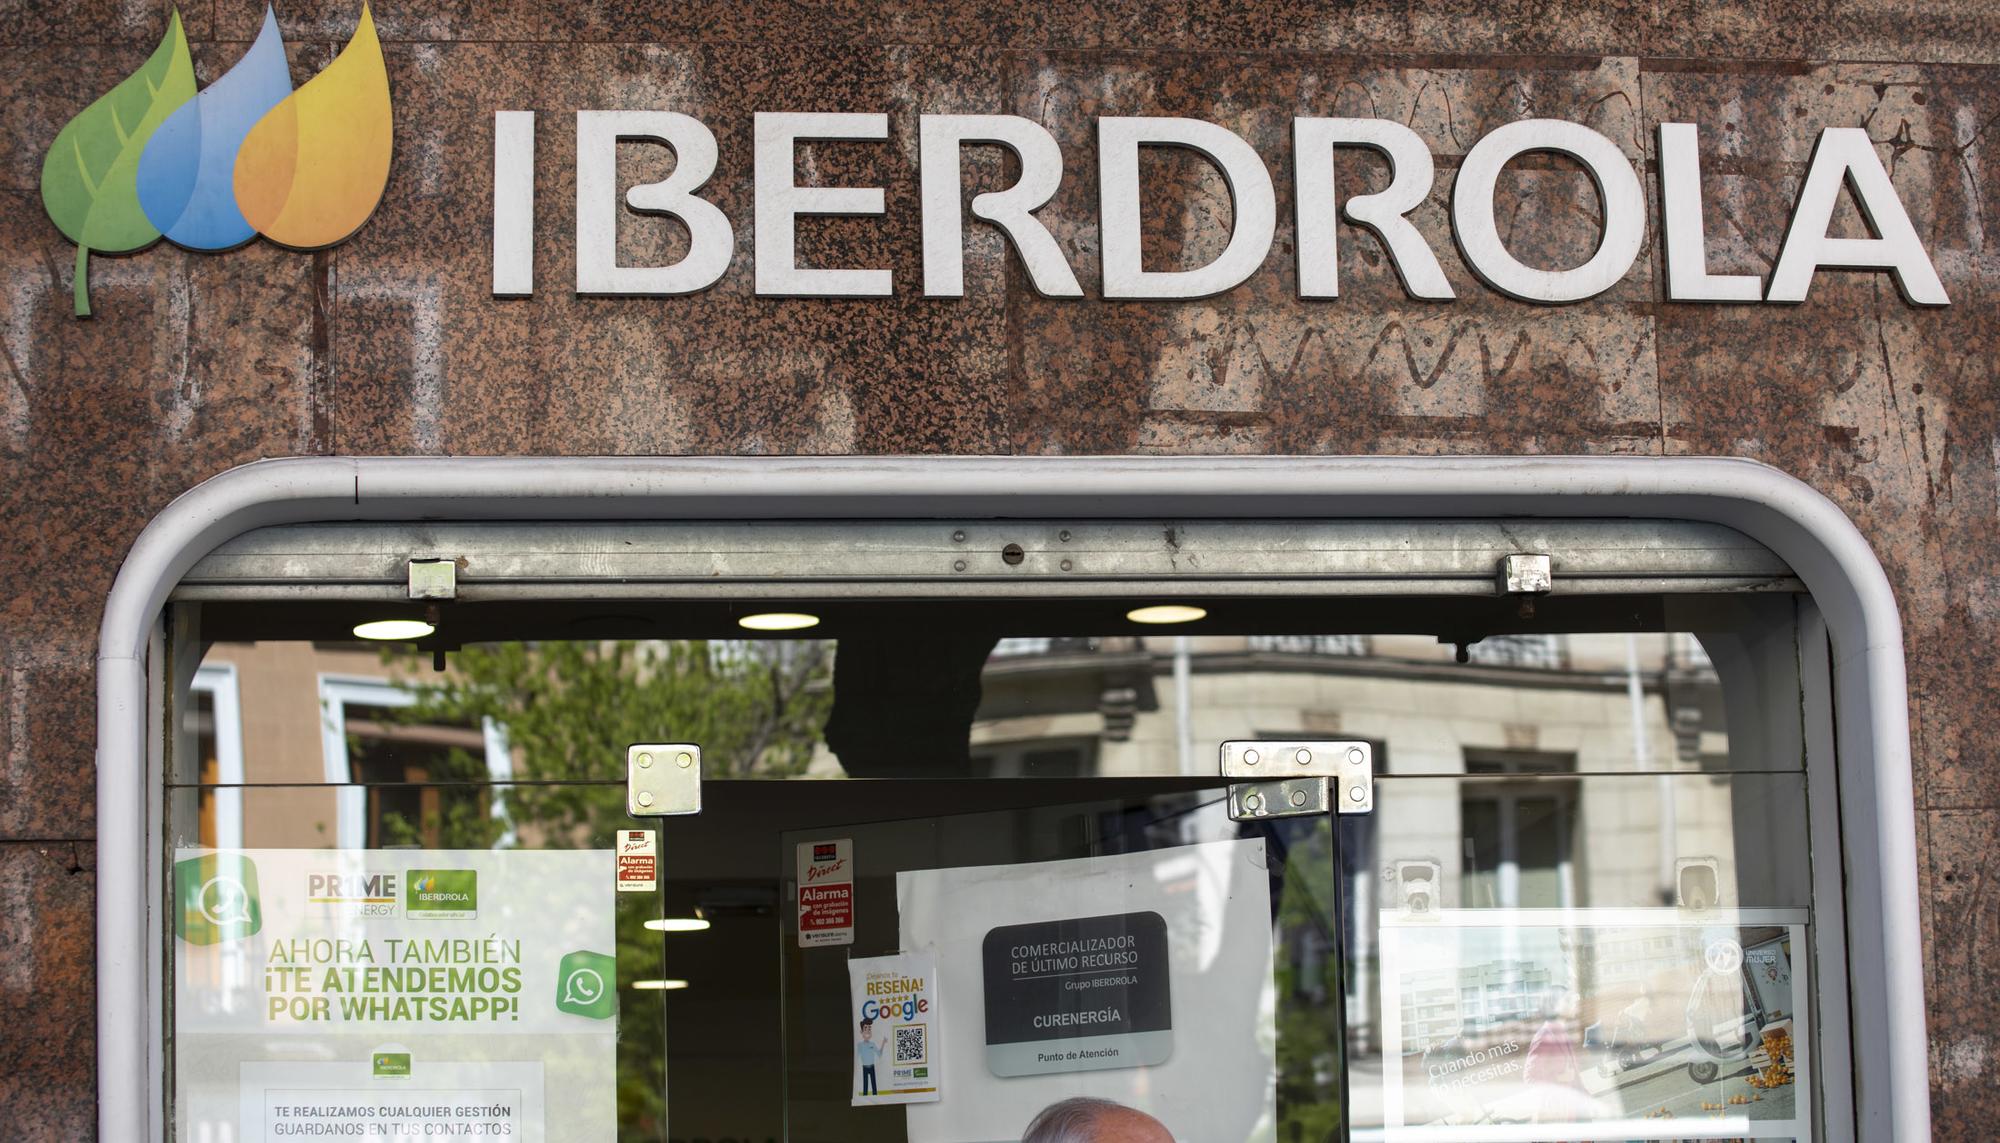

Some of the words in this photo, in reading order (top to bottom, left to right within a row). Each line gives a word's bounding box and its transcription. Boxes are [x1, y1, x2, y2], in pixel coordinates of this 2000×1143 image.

[493, 109, 1950, 305] IBERDROLA
[620, 857, 653, 865] Alarma
[807, 859, 847, 881] Direct
[419, 893, 469, 901] IBERDROLA
[802, 888, 849, 902] Alarma
[268, 939, 375, 964] AHORA
[384, 932, 521, 964] TAMBIÉN
[1011, 935, 1136, 959] COMERCIALIZADOR
[1012, 961, 1028, 975] DE
[1031, 957, 1079, 972] ÚLTIMO
[1082, 951, 1138, 968] RECURSO
[1746, 955, 1777, 963] MUJER
[265, 967, 312, 992] ¡TE
[321, 967, 522, 993] ATENDEMOS
[866, 976, 924, 996] RESEÑA!
[1065, 980, 1091, 991] Grupo
[1092, 975, 1138, 987] IBERDROLA
[269, 996, 331, 1021] POR
[340, 996, 518, 1021] WHATSAPP!
[862, 994, 928, 1021] Google
[1033, 1007, 1122, 1028] CURENERGÍA
[1038, 1051, 1064, 1062] Punto
[1066, 1050, 1077, 1060] de
[1079, 1048, 1119, 1059] Atención
[1428, 1050, 1486, 1079] Cuando
[1488, 1039, 1519, 1059] más
[1451, 1058, 1523, 1089] necesitas.
[275, 1106, 290, 1117] TE
[294, 1106, 375, 1117] REALIZAMOS
[379, 1106, 452, 1118] CUALQUIER
[456, 1103, 511, 1117] GESTIÓN
[274, 1122, 365, 1136] GUARDANOS
[369, 1123, 387, 1135] EN
[392, 1123, 420, 1136] TUS
[424, 1122, 511, 1136] CONTACTOS
